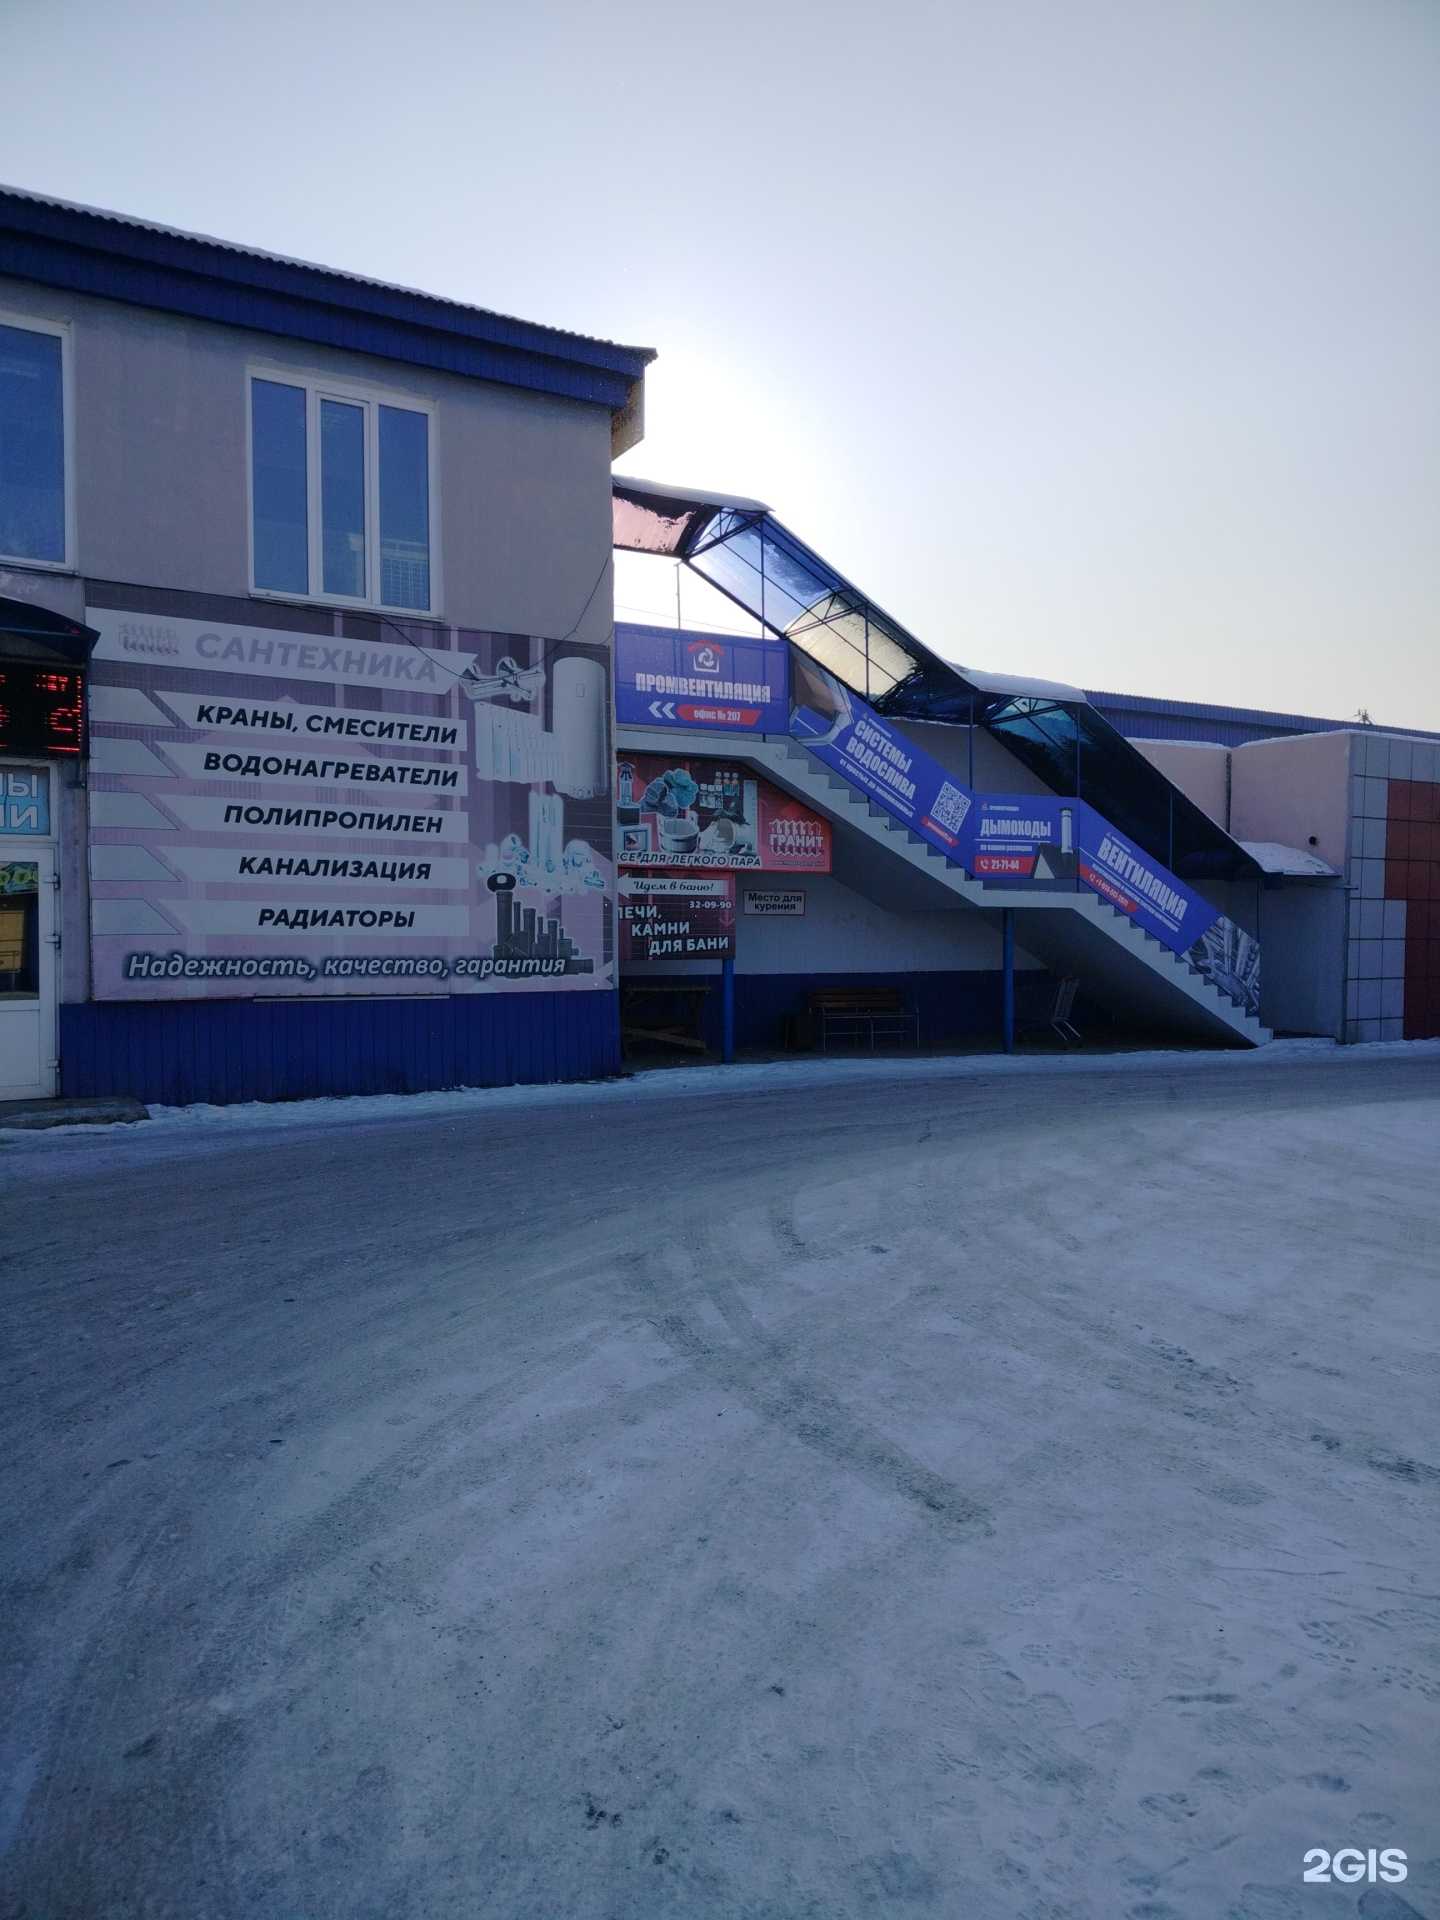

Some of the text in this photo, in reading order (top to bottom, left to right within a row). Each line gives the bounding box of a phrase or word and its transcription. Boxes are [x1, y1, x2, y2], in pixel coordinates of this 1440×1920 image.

[194, 632, 438, 683] САНТЕХНИКА
[635, 672, 771, 704] ПРОМВЕНТИЛЯЦИЯ
[197, 704, 458, 745] КРАНЫ, СМЕСИТЕЛИ
[727, 711, 741, 722] 207
[854, 719, 913, 773] СИСТЕМЫ
[204, 752, 458, 788] ВОДОНАГРЕВАТЕЛИ
[845, 736, 917, 800] ВОДОСЛИВА
[223, 804, 443, 835] ПОЛИПРОПИЛЕН
[980, 818, 1051, 839] ДЫМОХОДЫ
[768, 833, 824, 848] ГРАНИТ
[238, 855, 431, 883] КАНАЛИЗАЦИЯ
[617, 852, 636, 861] СЕ
[640, 853, 665, 864] ДЛЯ
[670, 854, 726, 866] ЛЕГКОГО
[730, 855, 761, 867] ПАРА
[634, 880, 667, 894] Идем
[679, 880, 714, 892] баню!
[1097, 837, 1188, 921] ВЕНТИЛЯЦИЯ
[689, 900, 732, 910] 32-09-90
[748, 893, 802, 904] Место для
[754, 902, 796, 912] курения
[258, 908, 415, 931] РАДИАТОРЫ
[631, 921, 690, 937] КАМНИ
[649, 936, 729, 956] ДЛЯ БАНИ
[128, 954, 566, 980] Надежность, качество, гарантия
